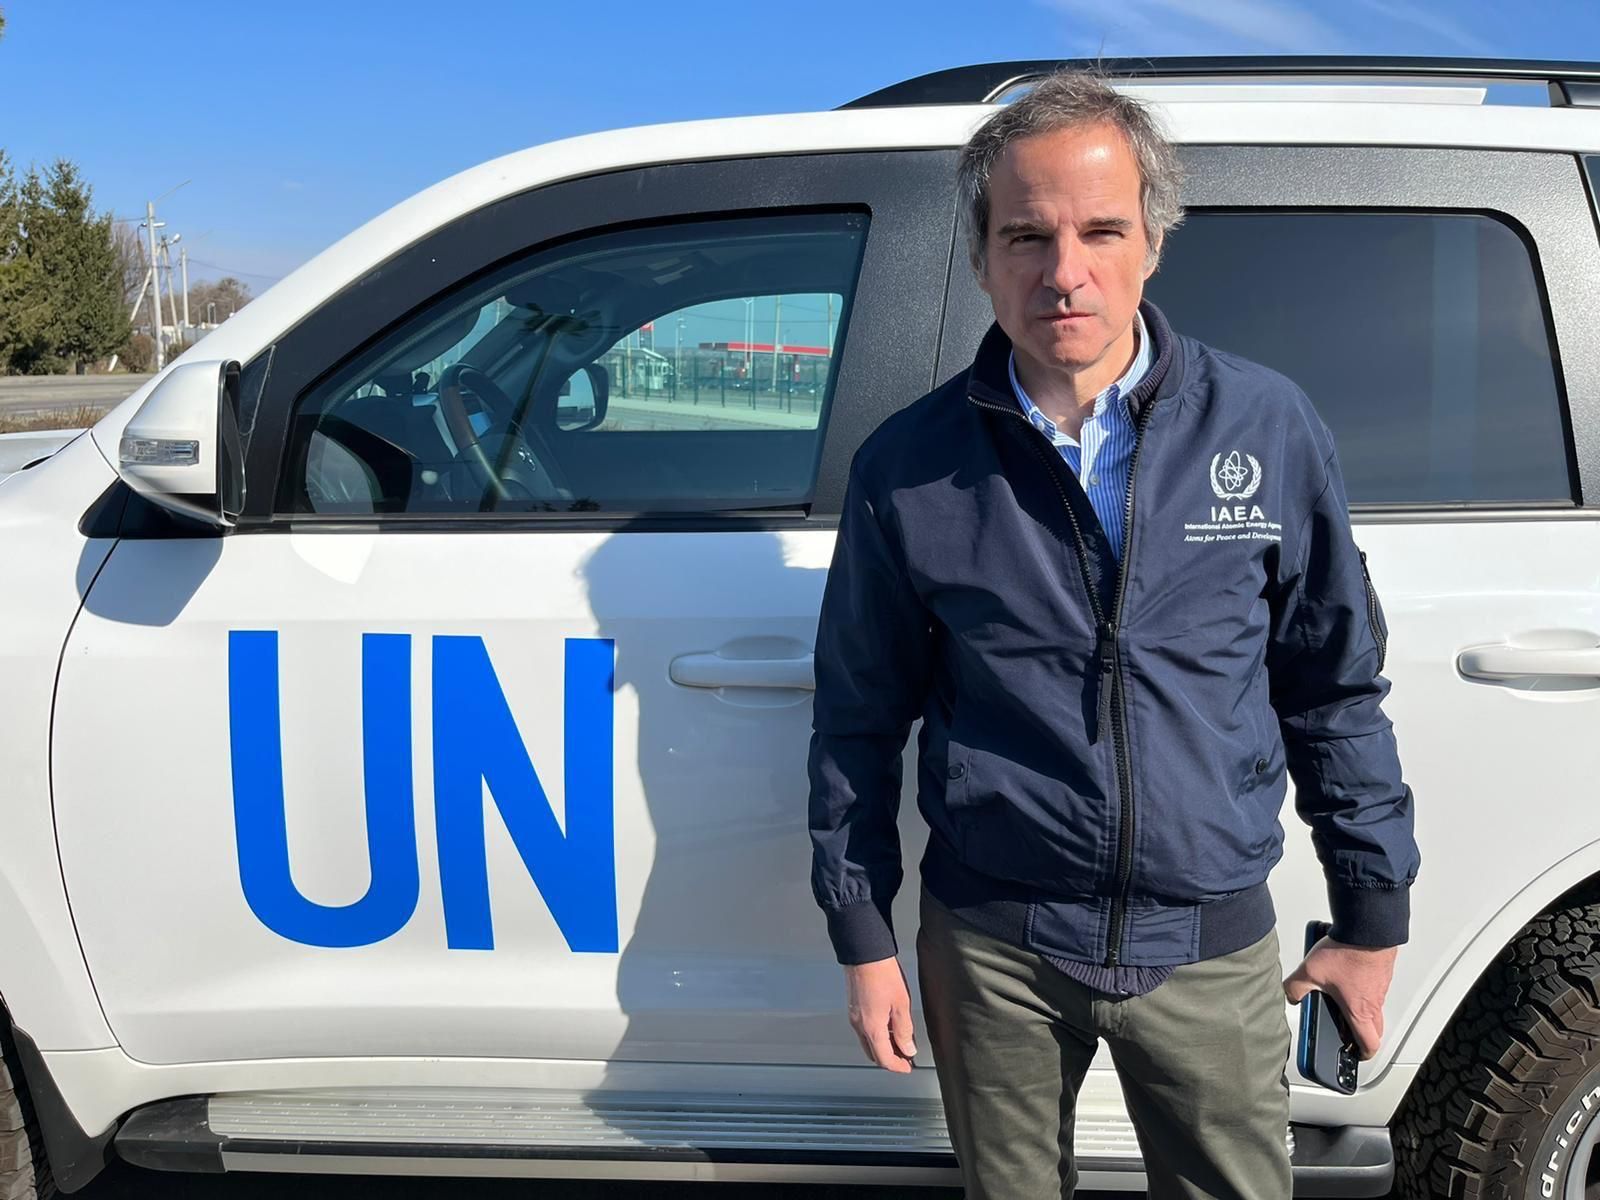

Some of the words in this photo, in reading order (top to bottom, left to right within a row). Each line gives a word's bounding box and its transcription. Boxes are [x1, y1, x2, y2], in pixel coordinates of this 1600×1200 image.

[1211, 505, 1265, 521] IAEA
[1222, 522, 1244, 530] Atomic
[1246, 521, 1267, 529] Energy
[1204, 535, 1215, 543] for
[1216, 533, 1236, 541] Peace
[1237, 532, 1251, 540] and
[229, 631, 618, 953] UN
